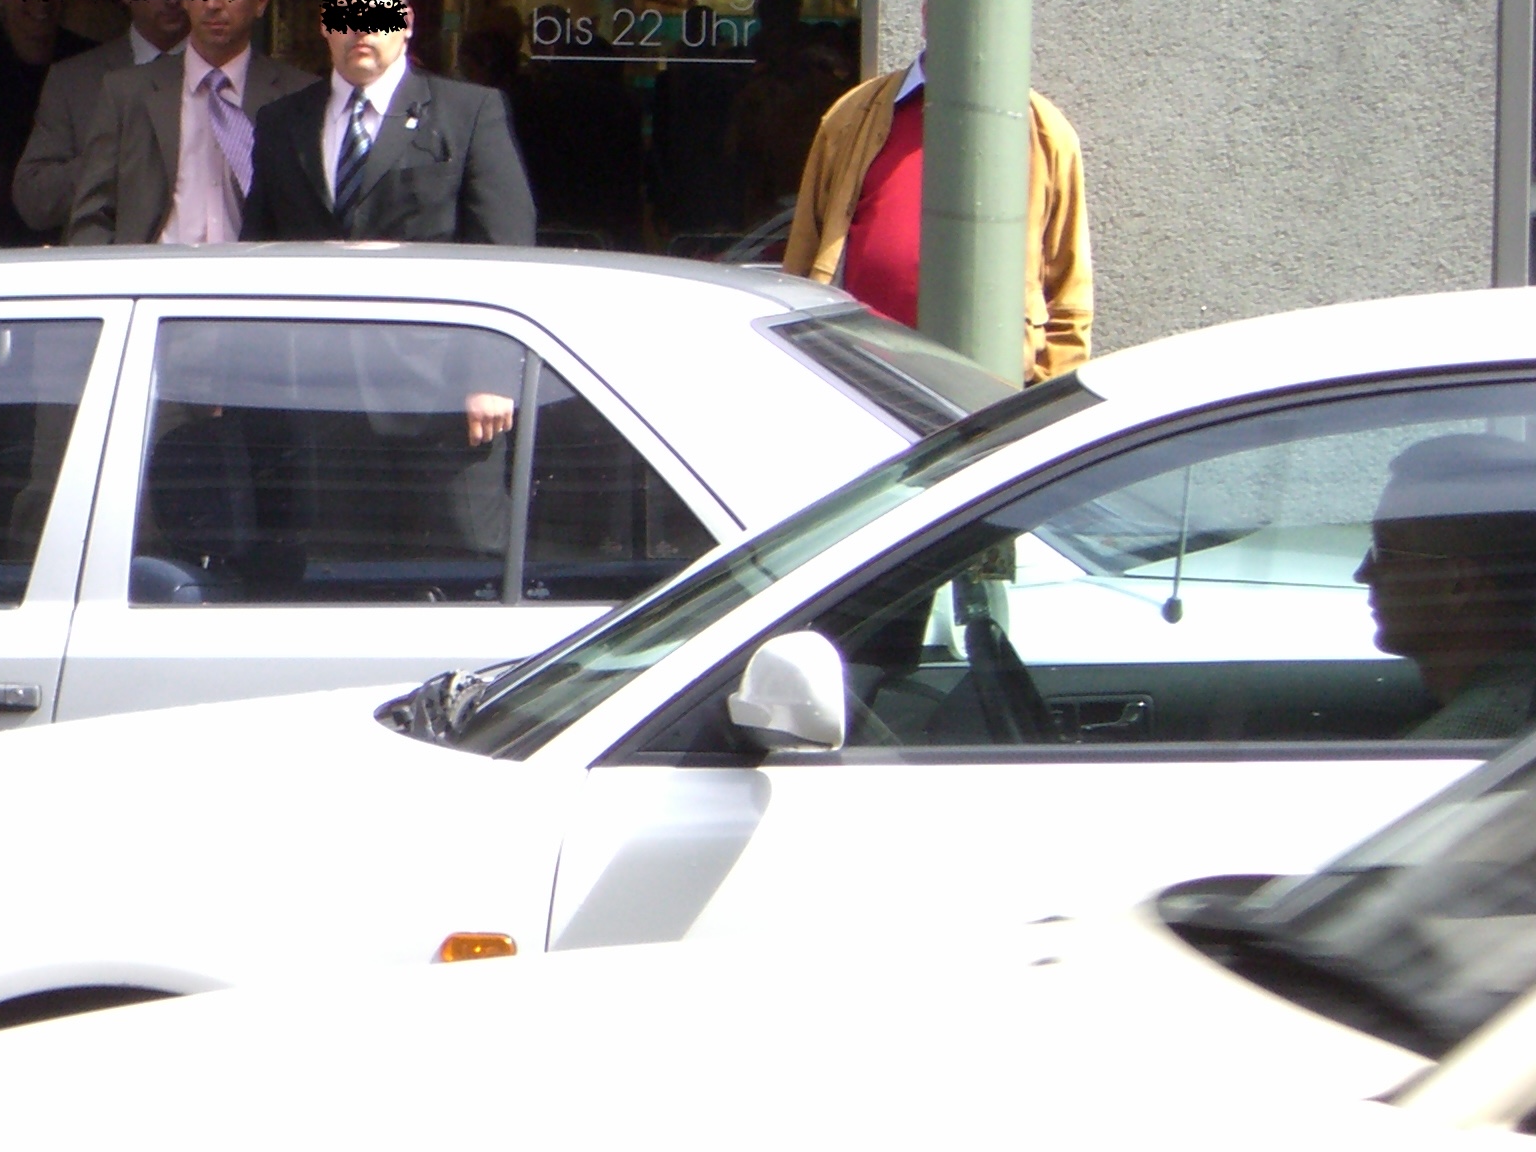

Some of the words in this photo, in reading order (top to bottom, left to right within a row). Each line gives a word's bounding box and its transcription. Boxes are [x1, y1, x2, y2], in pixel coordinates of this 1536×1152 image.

[532, 6, 594, 46] bis
[612, 7, 663, 47] 22
[681, 9, 757, 48] Uhr
